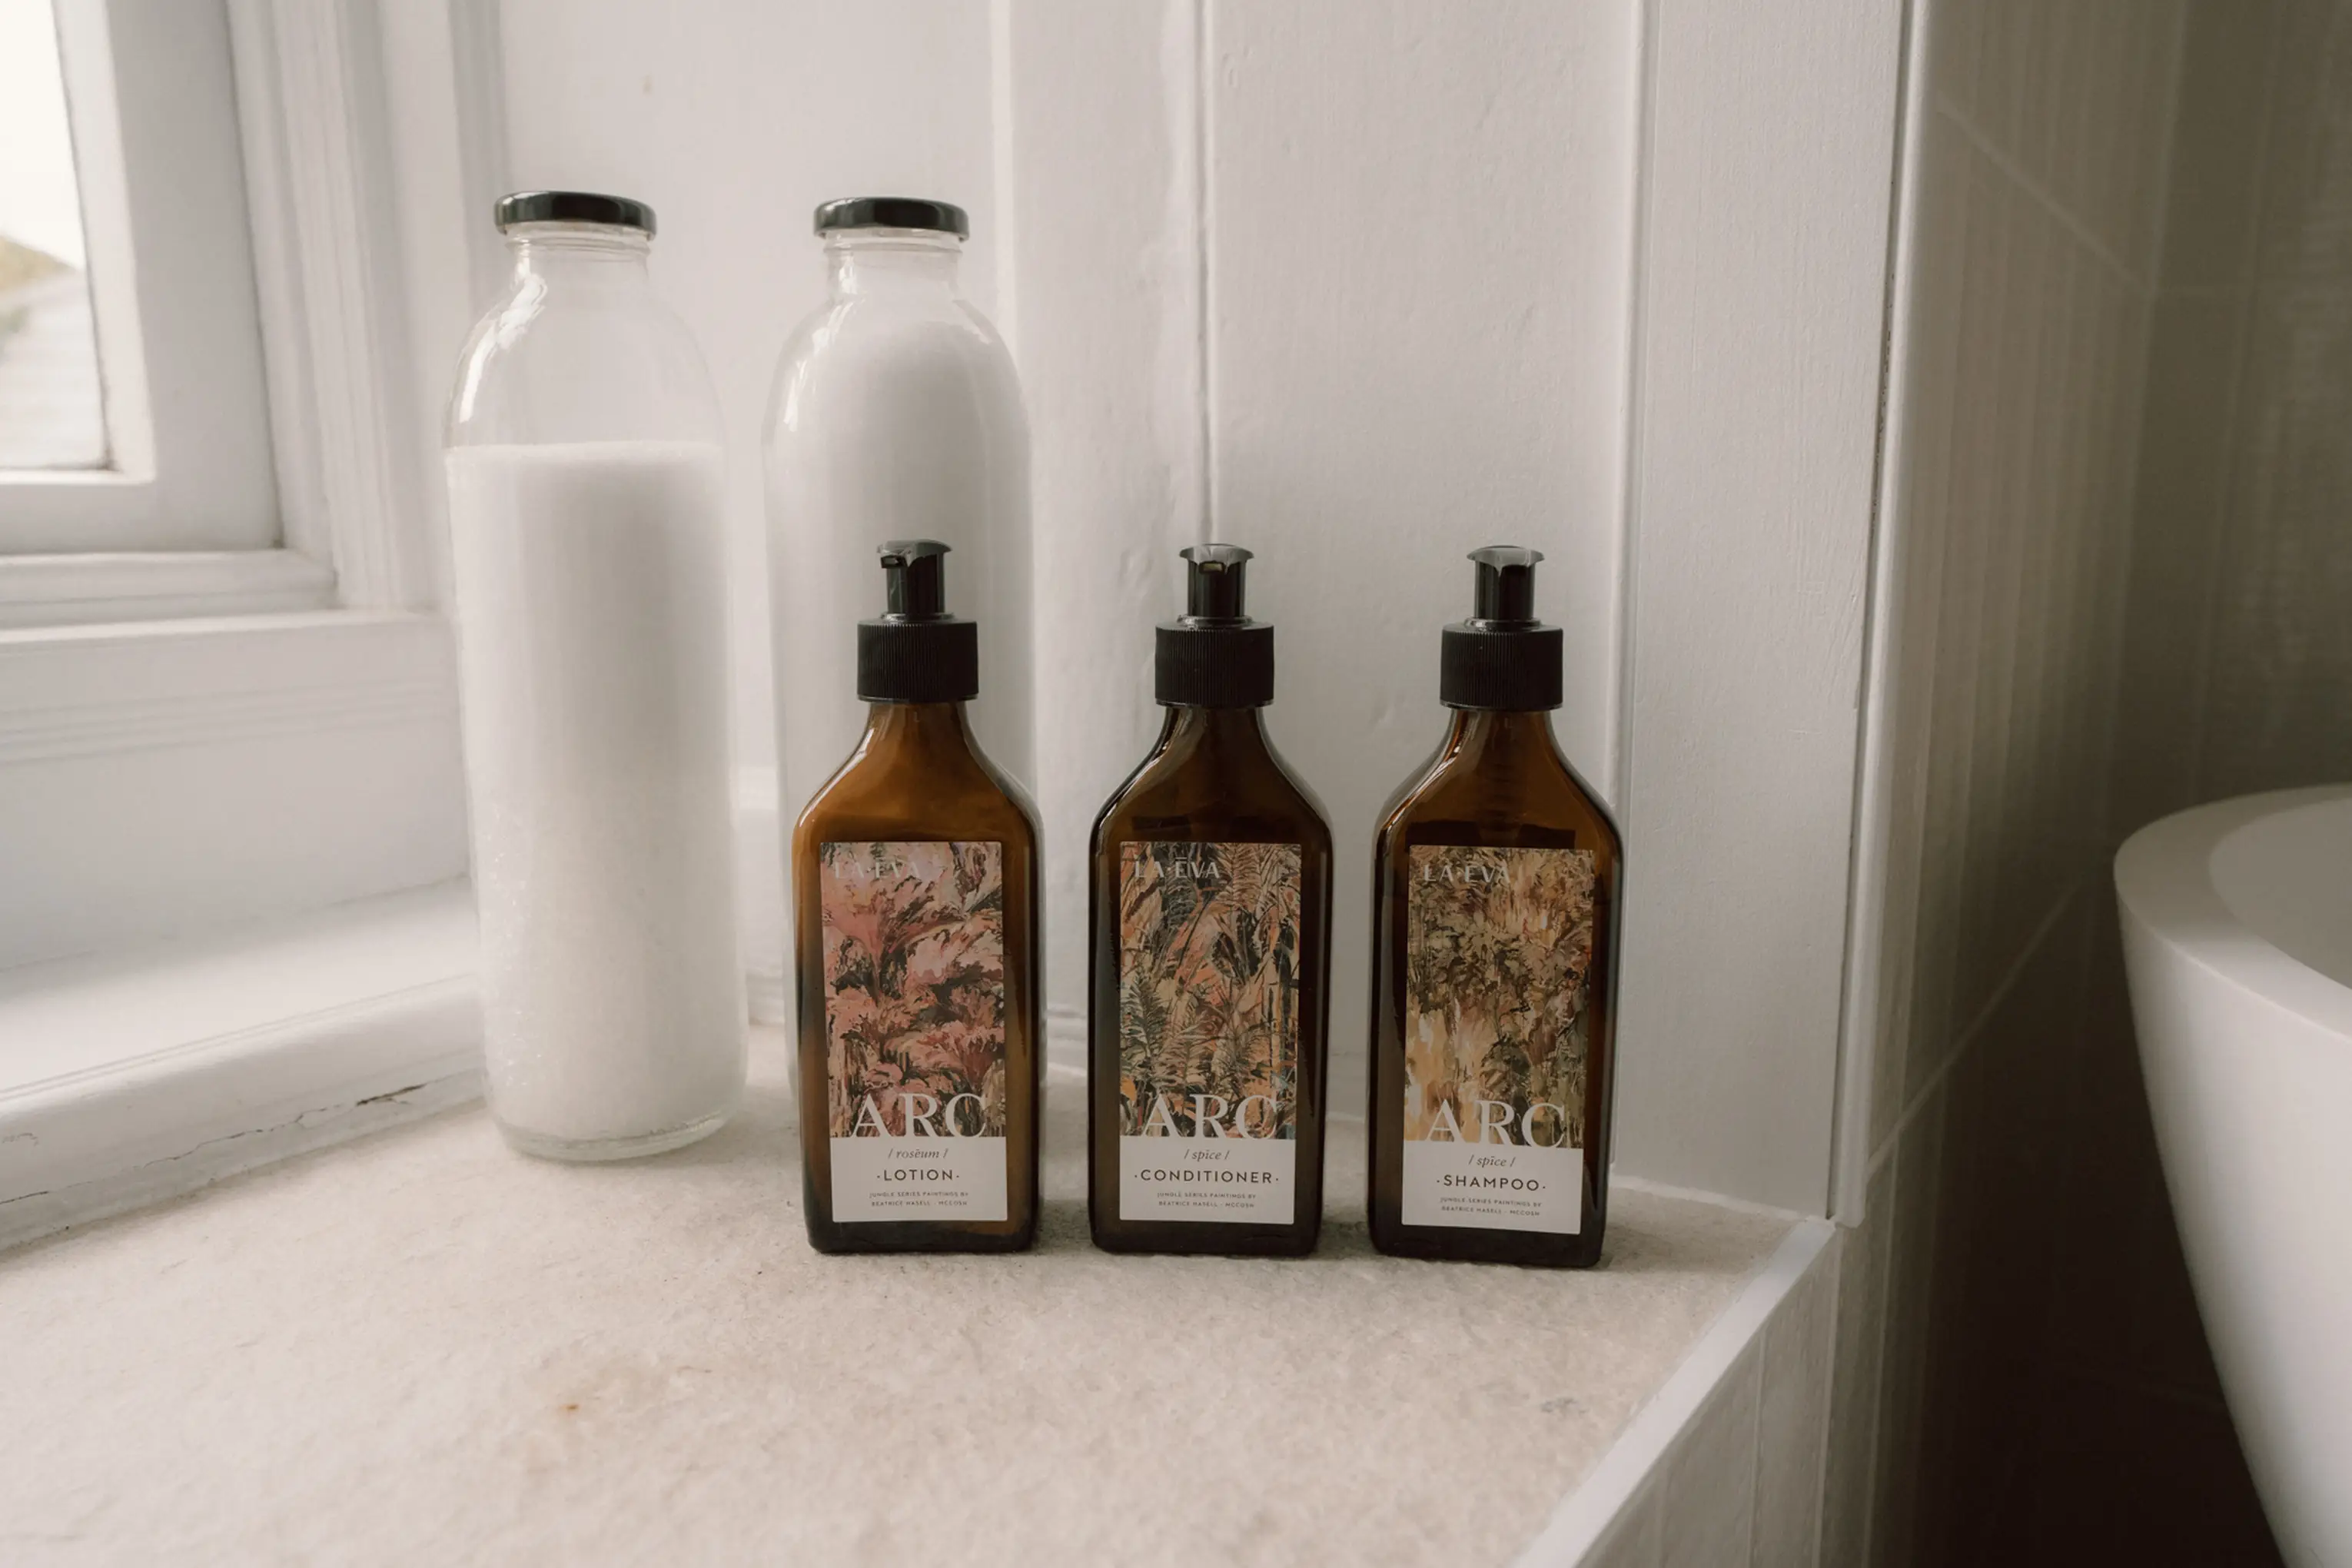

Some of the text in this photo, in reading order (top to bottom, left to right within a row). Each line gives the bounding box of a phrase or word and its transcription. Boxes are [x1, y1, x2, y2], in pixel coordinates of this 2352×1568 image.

[850, 1092, 988, 1138] ARC
[1140, 1093, 1278, 1141] ARC
[1425, 1098, 1566, 1148] ARC
